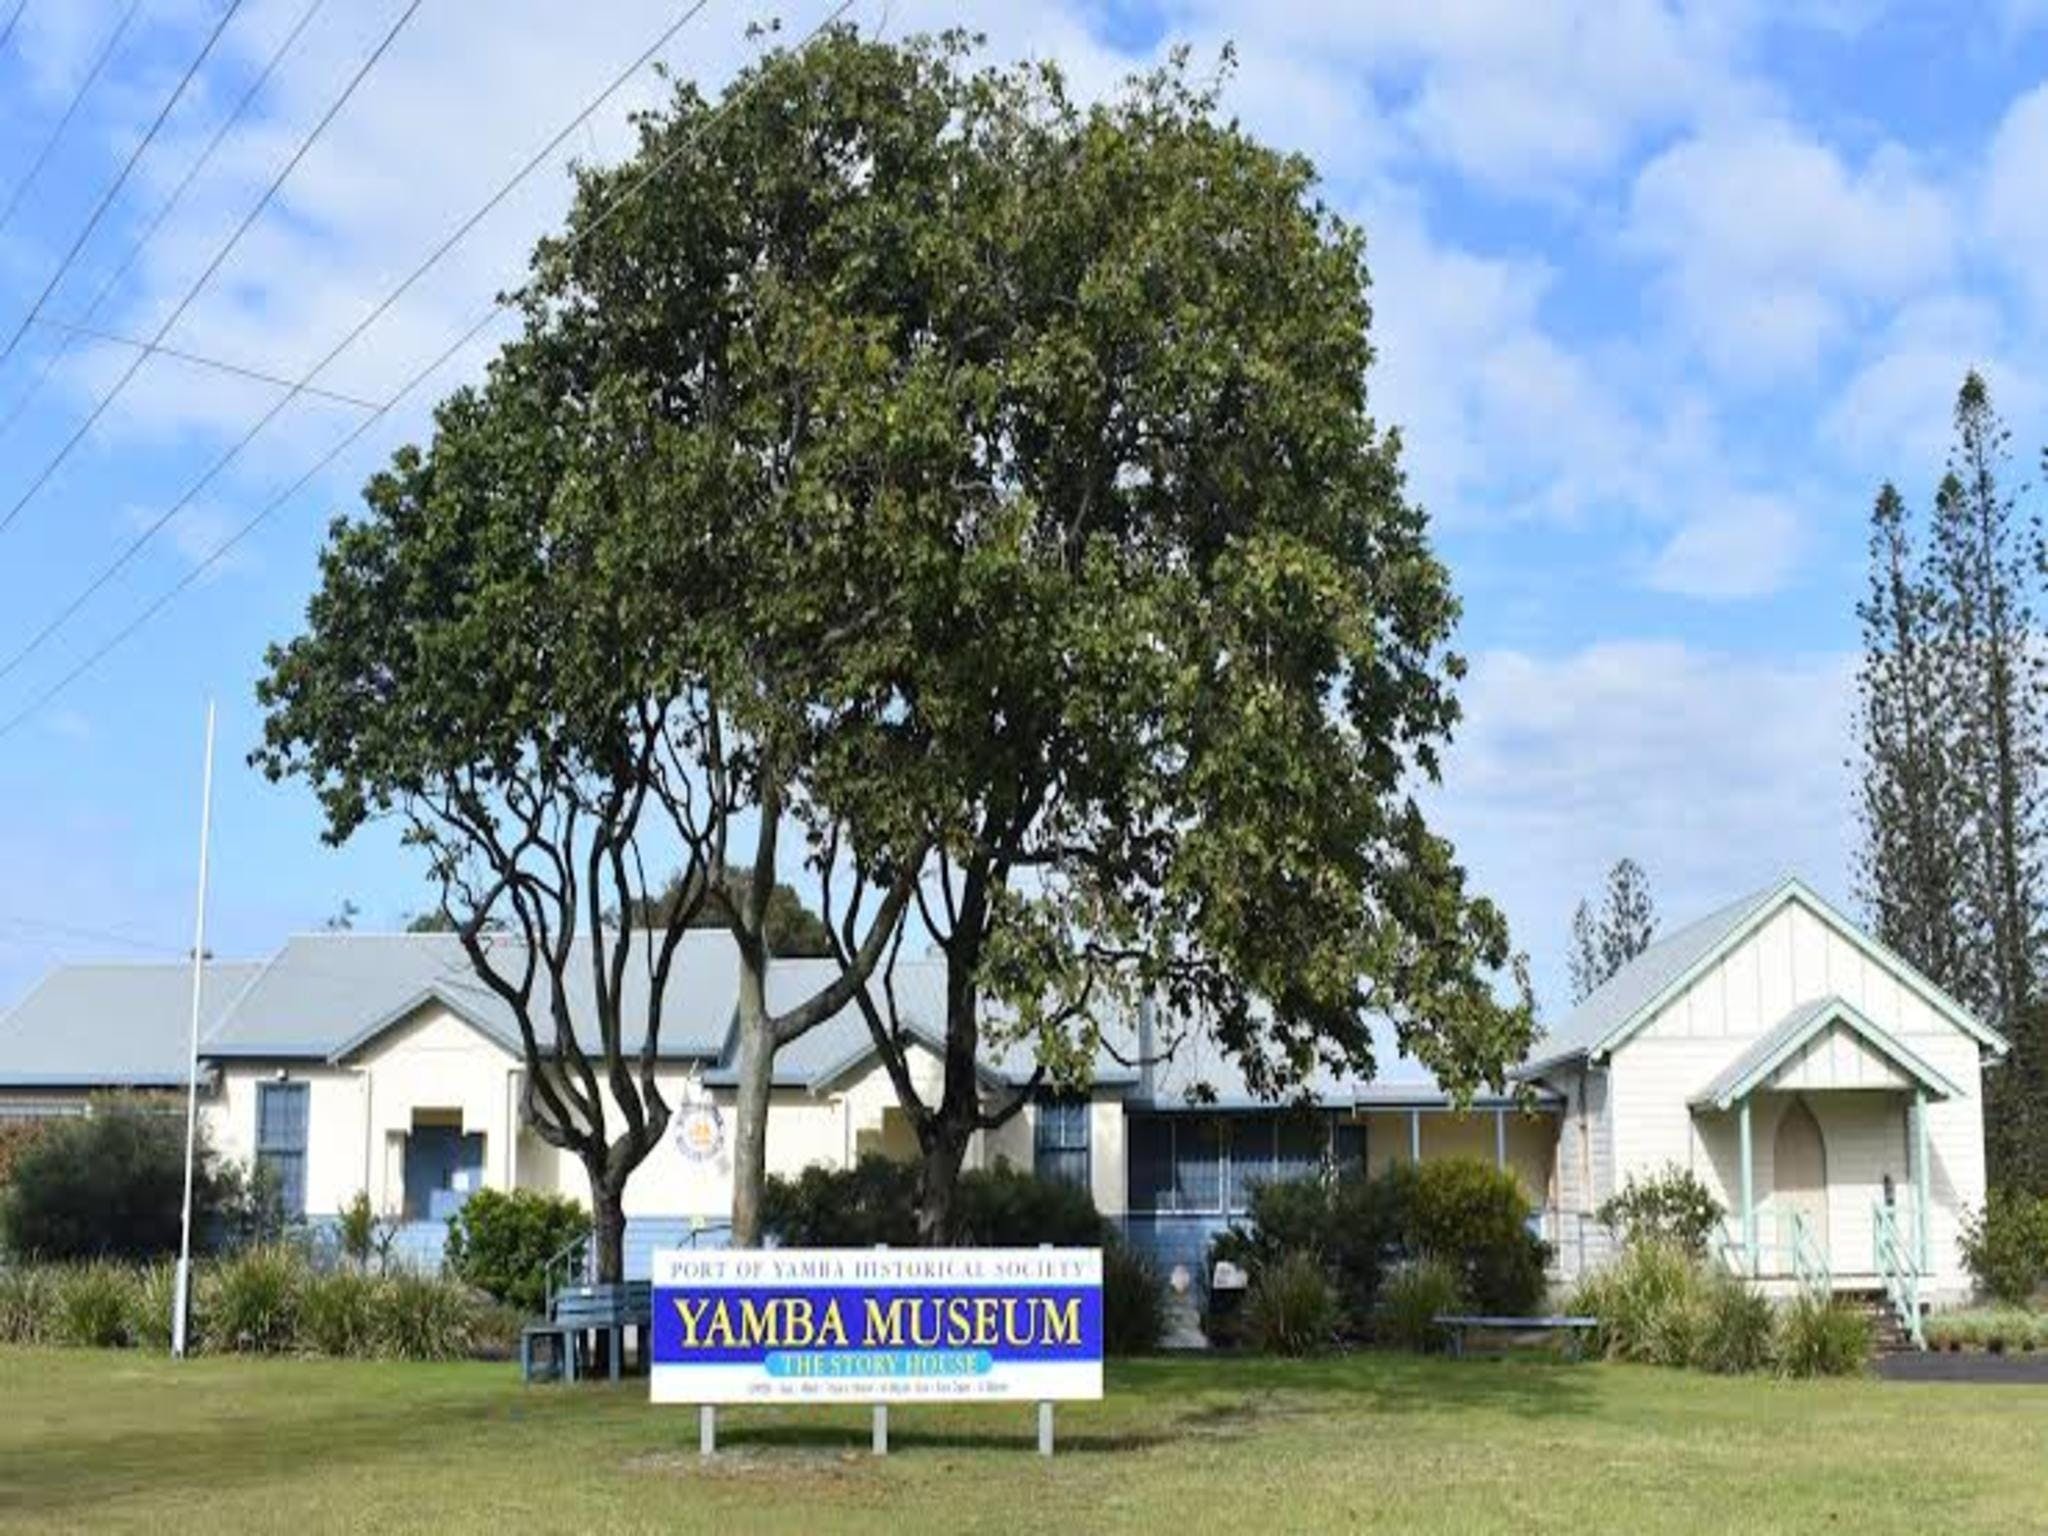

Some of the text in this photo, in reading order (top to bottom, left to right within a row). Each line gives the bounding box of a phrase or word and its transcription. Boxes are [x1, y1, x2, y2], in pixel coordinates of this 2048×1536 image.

[671, 1260, 1085, 1279] PORT OF YAMBA HISTORICAL SOCIETY
[673, 1297, 1083, 1348] YAMBA MUSEUM
[785, 1353, 977, 1376] THE STORY HOUSE
